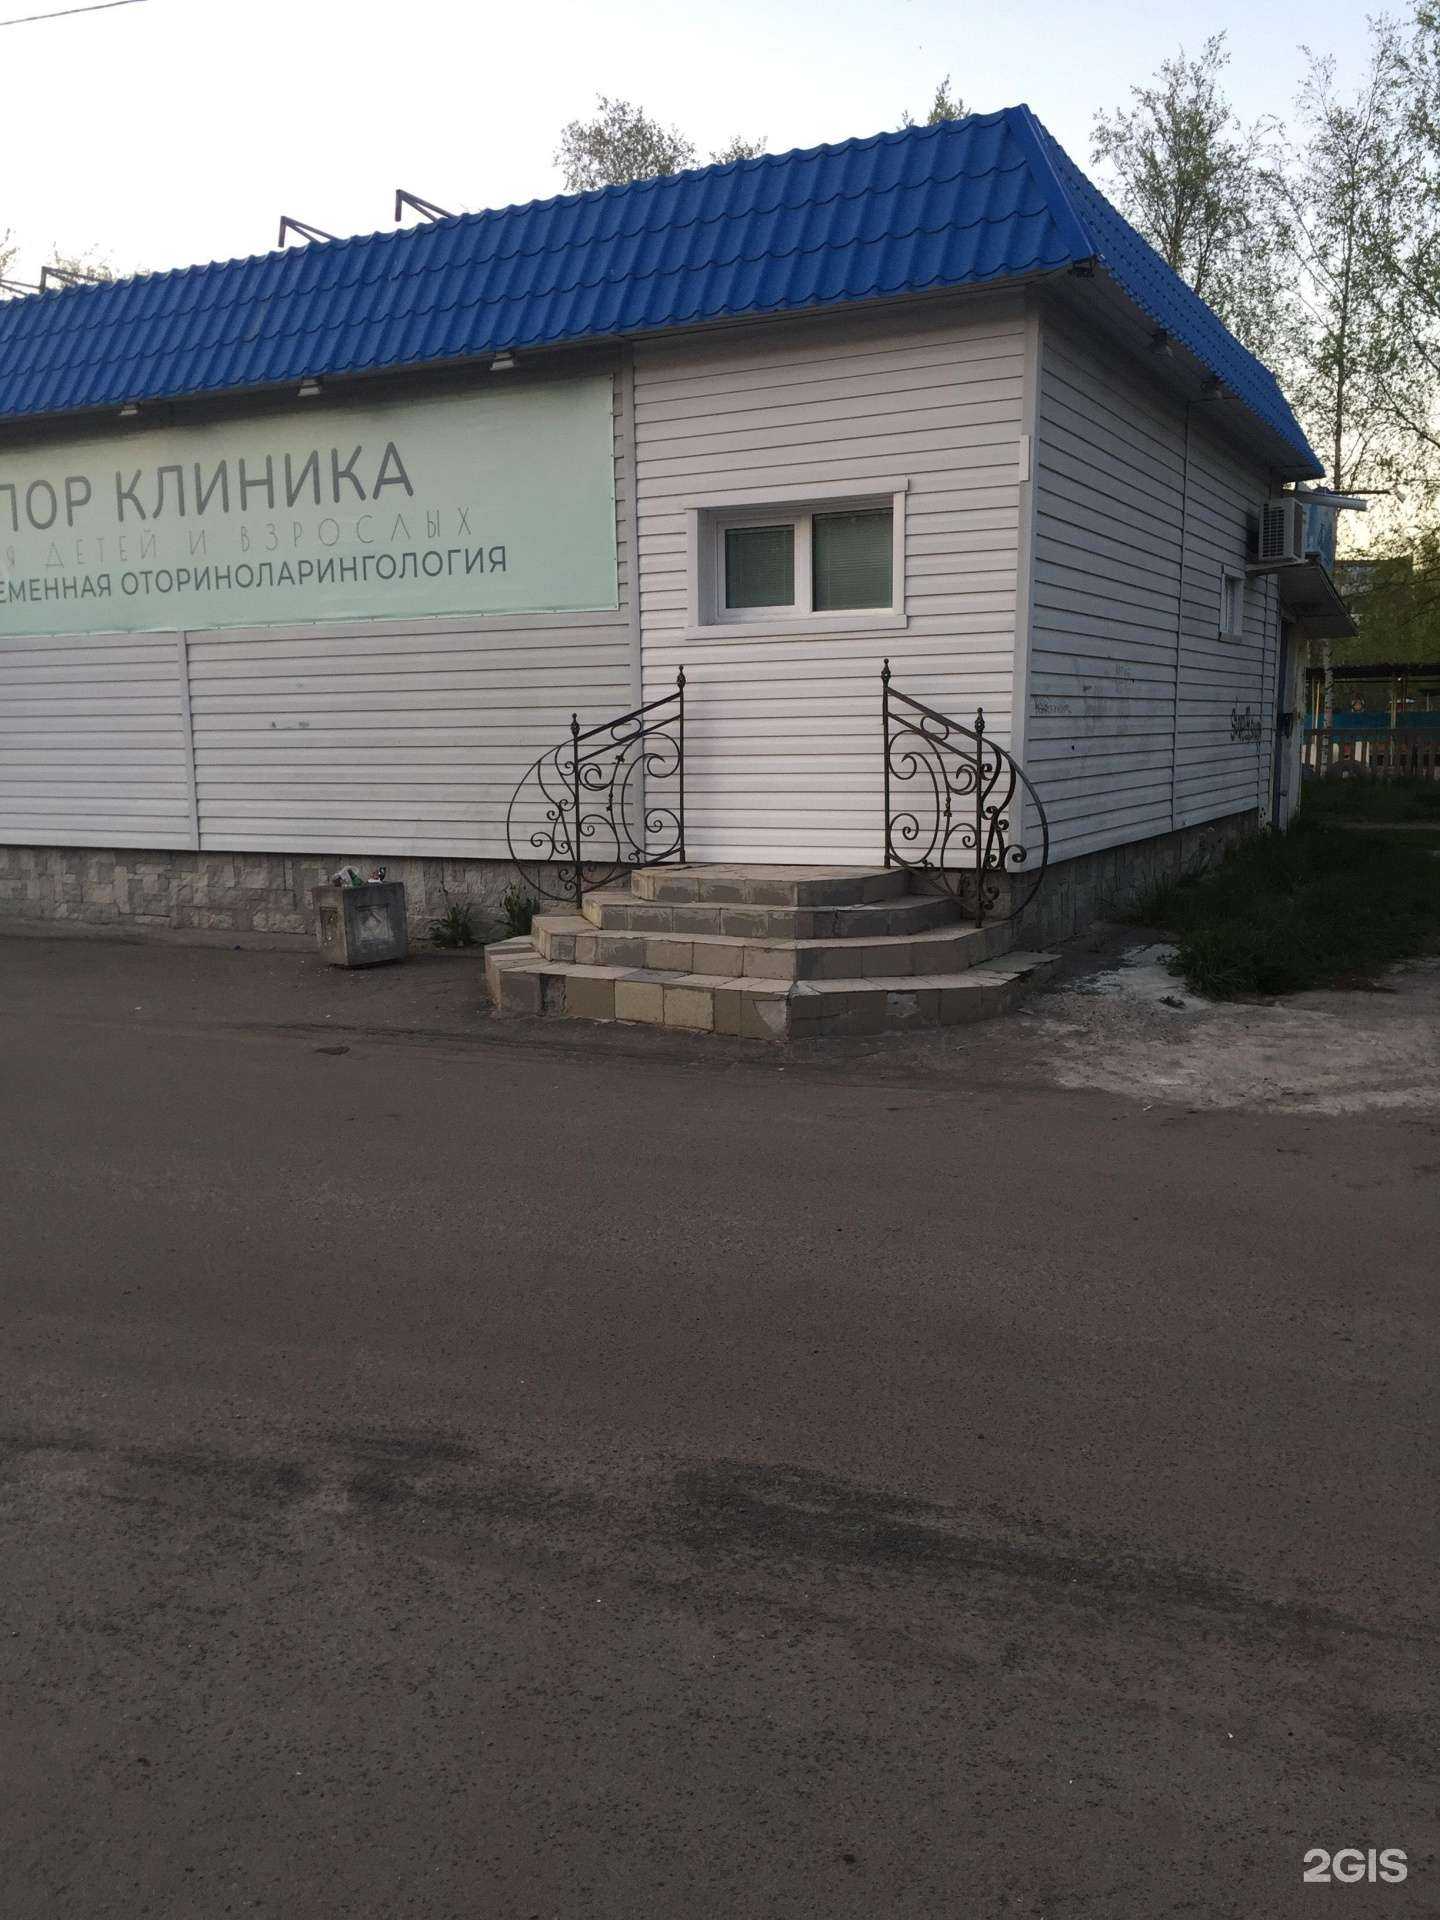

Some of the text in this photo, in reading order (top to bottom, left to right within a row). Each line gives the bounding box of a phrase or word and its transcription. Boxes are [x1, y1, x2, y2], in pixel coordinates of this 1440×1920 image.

[115, 441, 414, 522] КЛИНИКА
[45, 530, 157, 569] ДЕТЕЙ
[188, 529, 207, 555] И
[239, 507, 472, 553] ВЗРОСЛЫХ
[121, 546, 507, 596] ОТОРИНОЛАРИНГОЛОГИЯ
